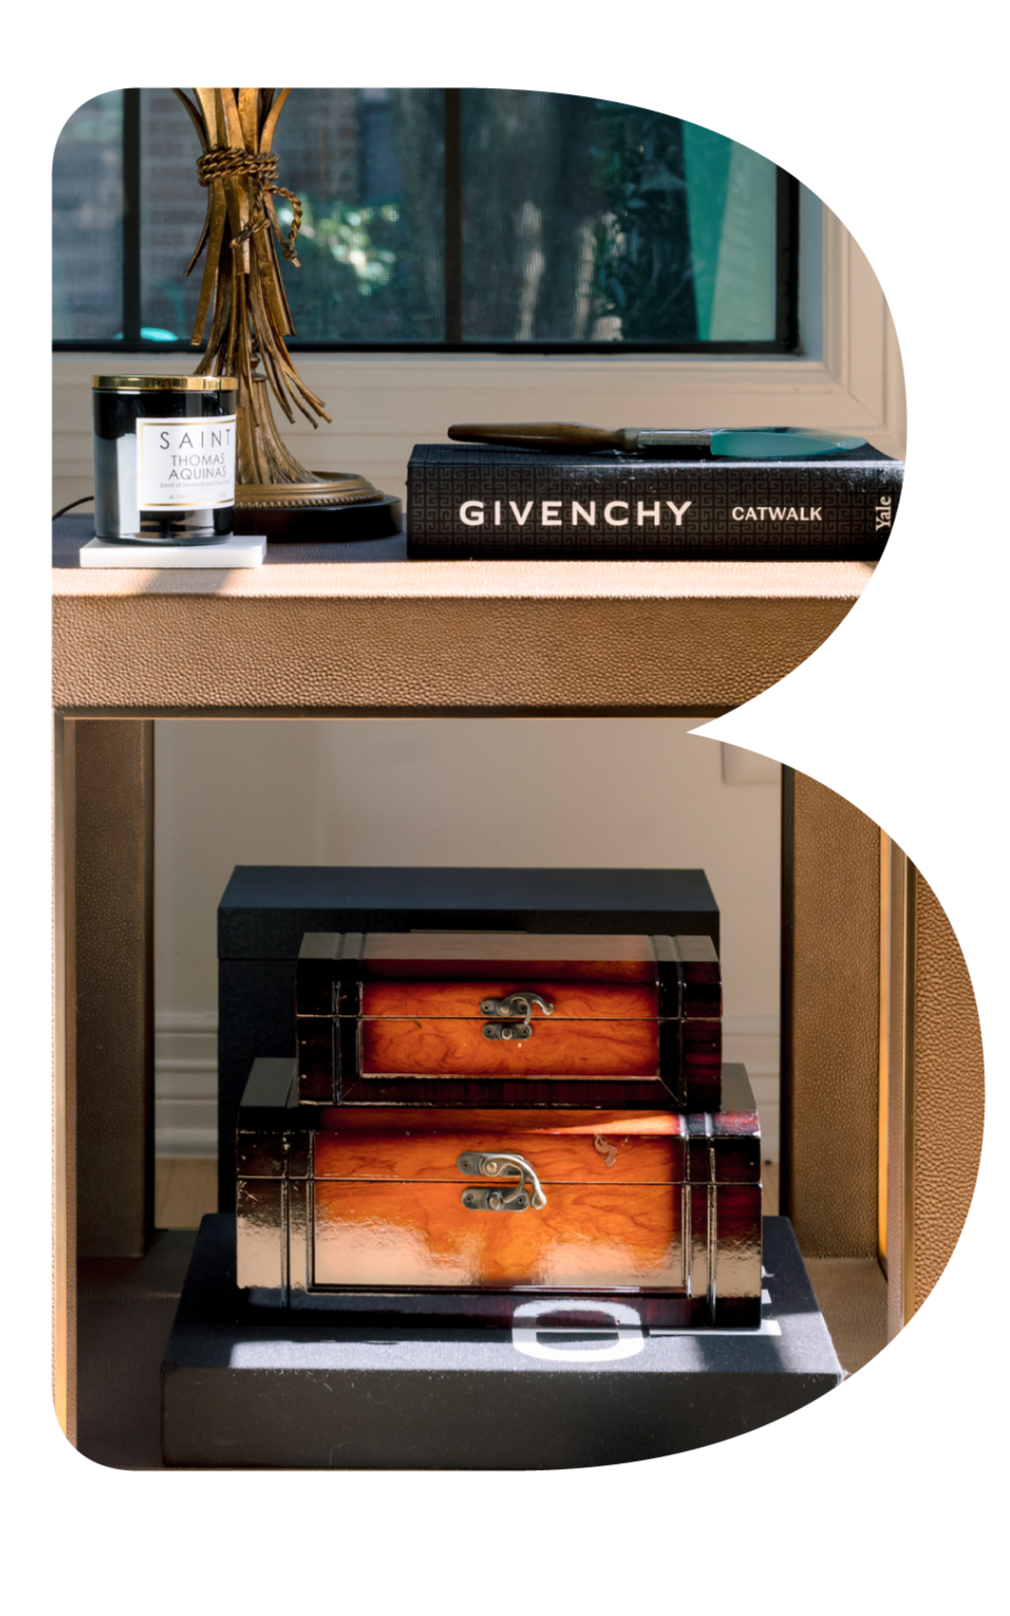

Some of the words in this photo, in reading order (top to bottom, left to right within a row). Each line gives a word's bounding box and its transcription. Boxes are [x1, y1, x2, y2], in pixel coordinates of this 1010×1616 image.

[159, 428, 231, 450] SAINT
[171, 452, 225, 467] THOMAS
[168, 465, 227, 481] AQUINAS
[459, 500, 692, 527] GIVENCHY
[731, 506, 823, 521] CATWALK
[875, 496, 892, 531] Yale
